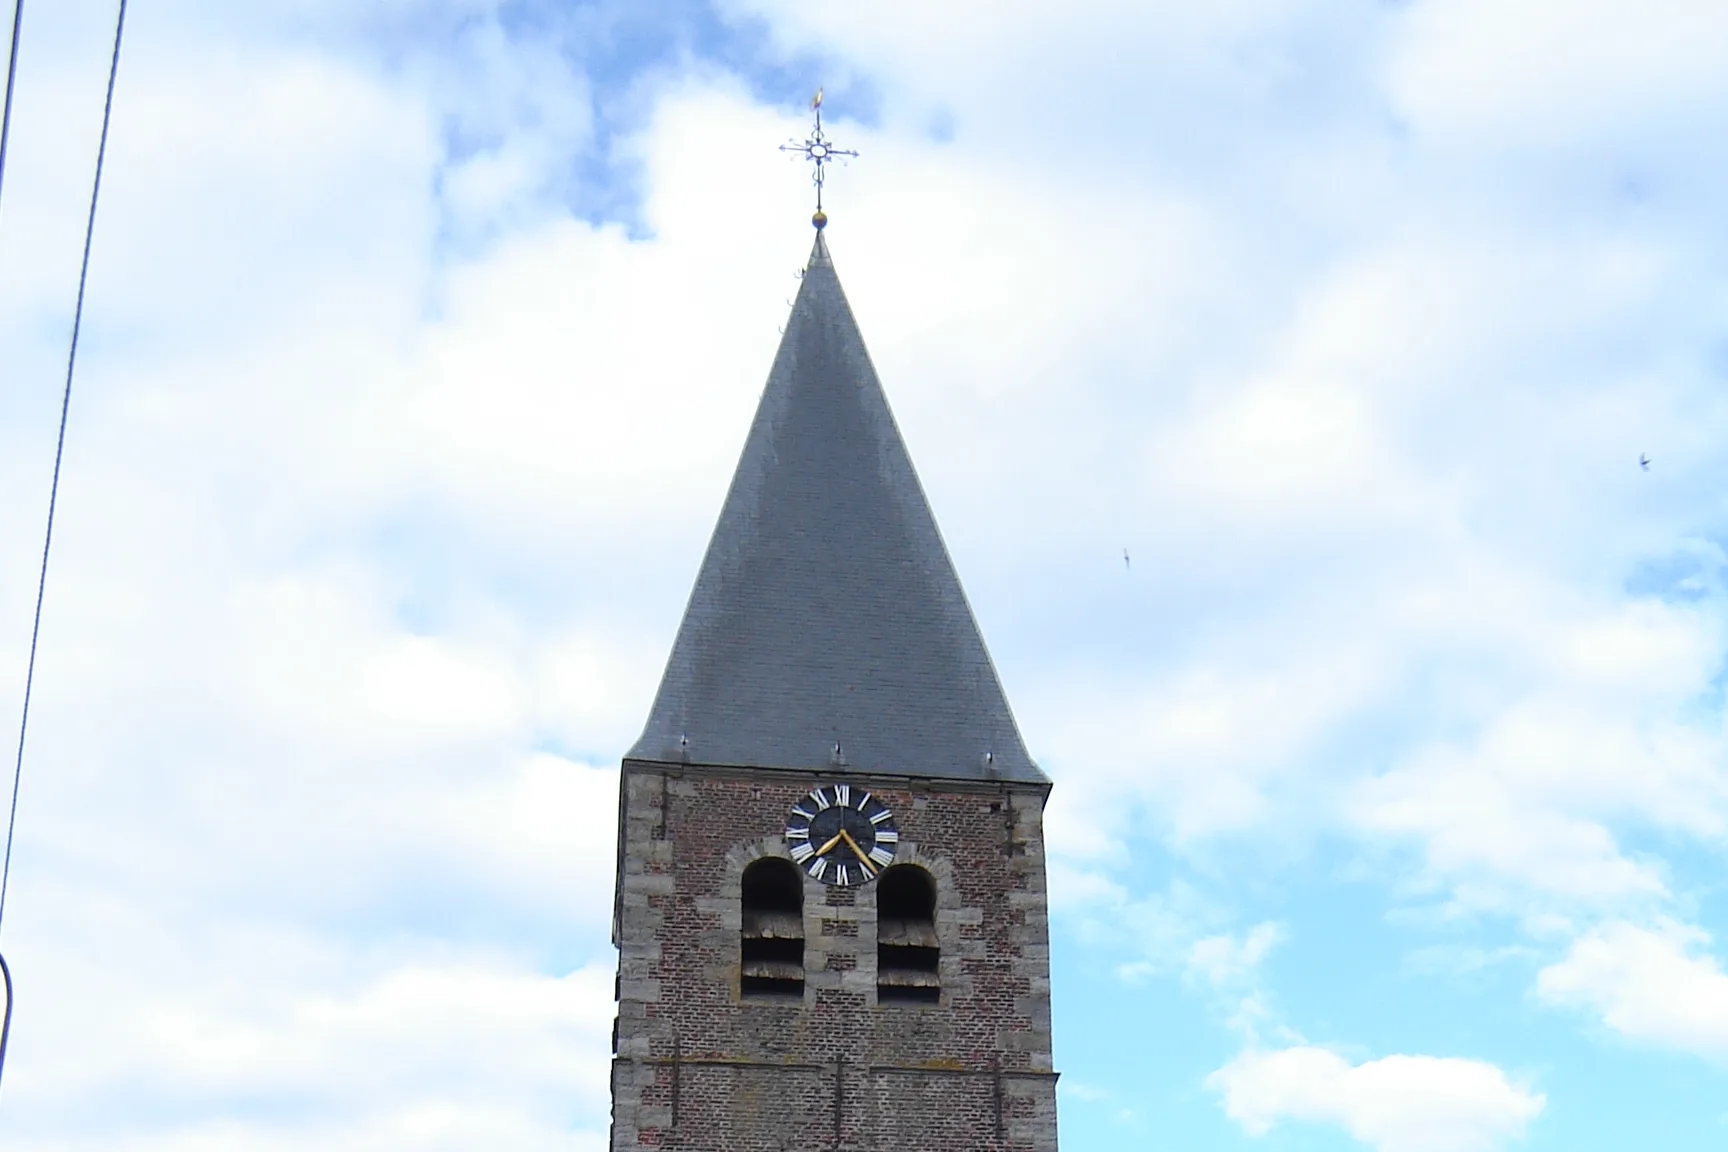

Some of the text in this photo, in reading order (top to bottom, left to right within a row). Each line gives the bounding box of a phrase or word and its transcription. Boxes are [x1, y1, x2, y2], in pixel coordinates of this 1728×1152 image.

[809, 788, 830, 811] XI
[834, 785, 850, 807] XII
[857, 792, 872, 811] I
[792, 804, 816, 822] X
[869, 809, 893, 825] II
[785, 826, 809, 839] IX
[875, 832, 899, 842] III
[789, 842, 816, 865] VIII
[808, 857, 828, 880] VII
[837, 864, 849, 886] VI
[859, 862, 875, 881] V
